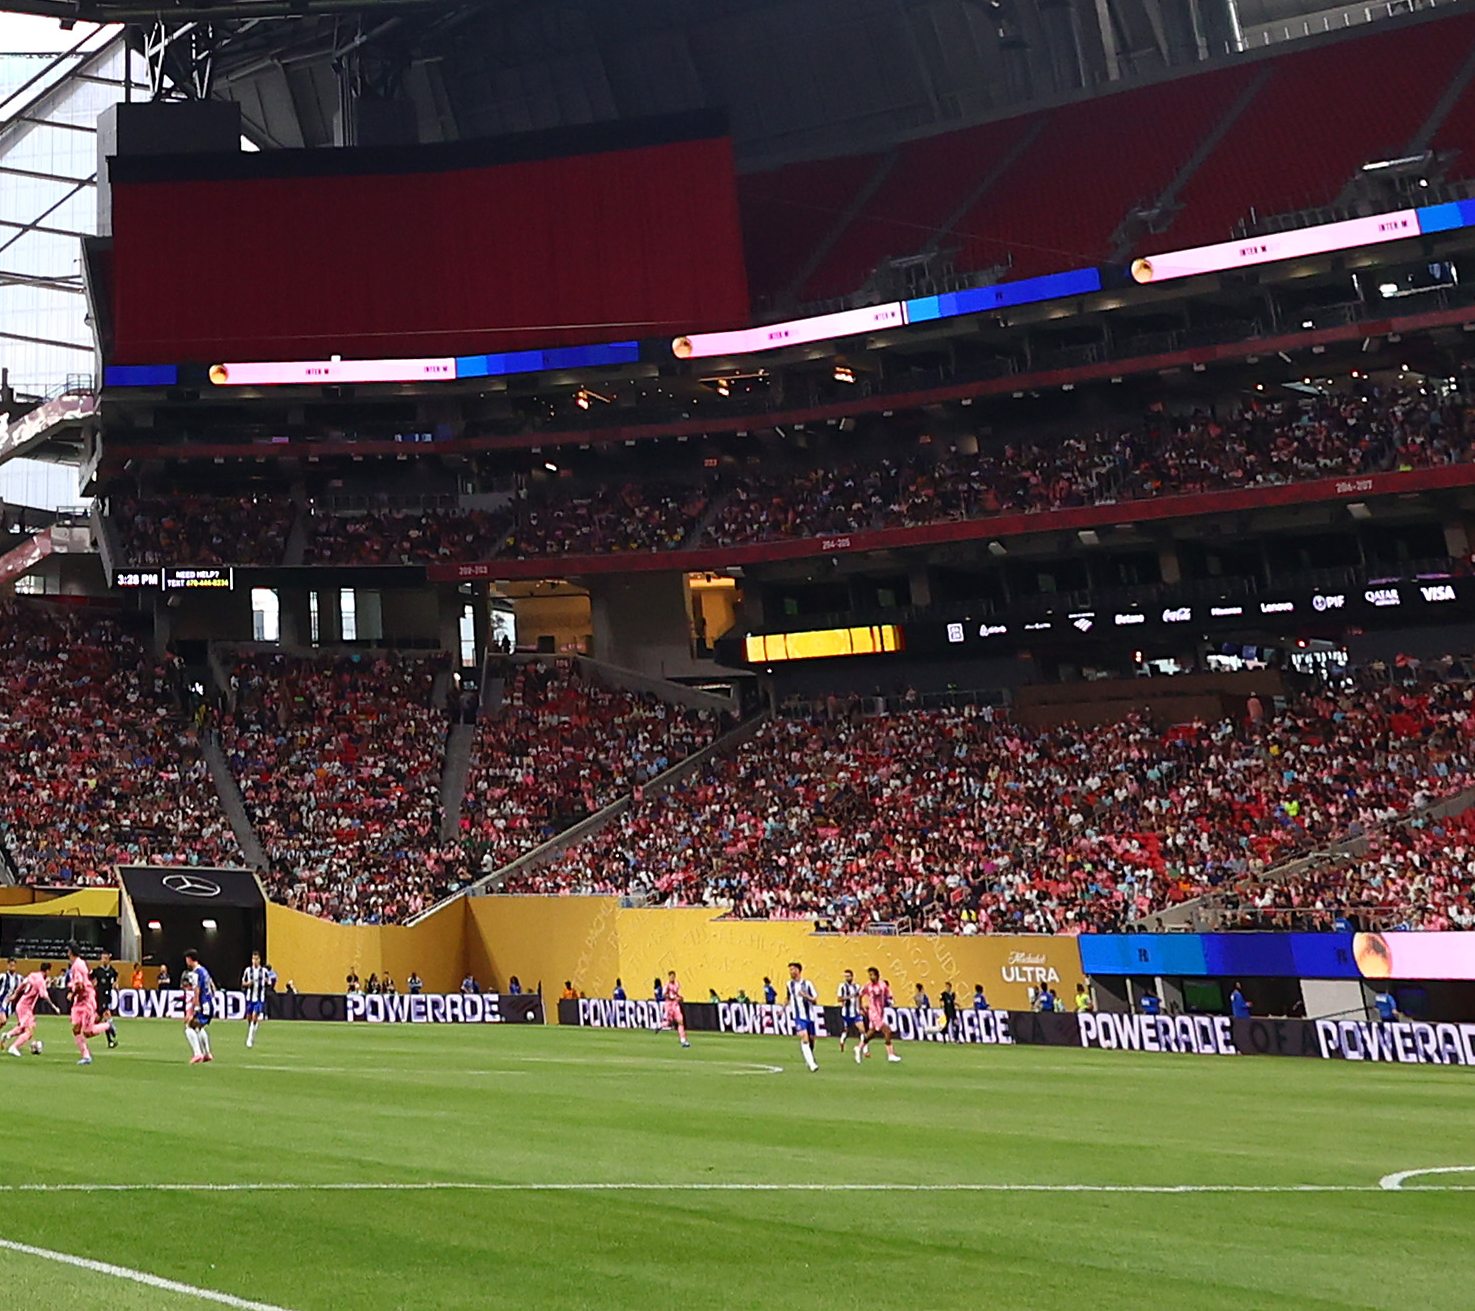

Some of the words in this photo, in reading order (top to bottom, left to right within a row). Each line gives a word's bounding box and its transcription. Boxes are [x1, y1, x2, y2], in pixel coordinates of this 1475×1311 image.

[141, 574, 159, 586] PM
[1325, 595, 1345, 608] PIF
[1364, 589, 1399, 603] QATAR
[1420, 585, 1456, 602] VISA
[1001, 966, 1061, 983] ULTRA
[346, 993, 501, 1025] POWERADE
[1078, 1012, 1238, 1055] POWERADE
